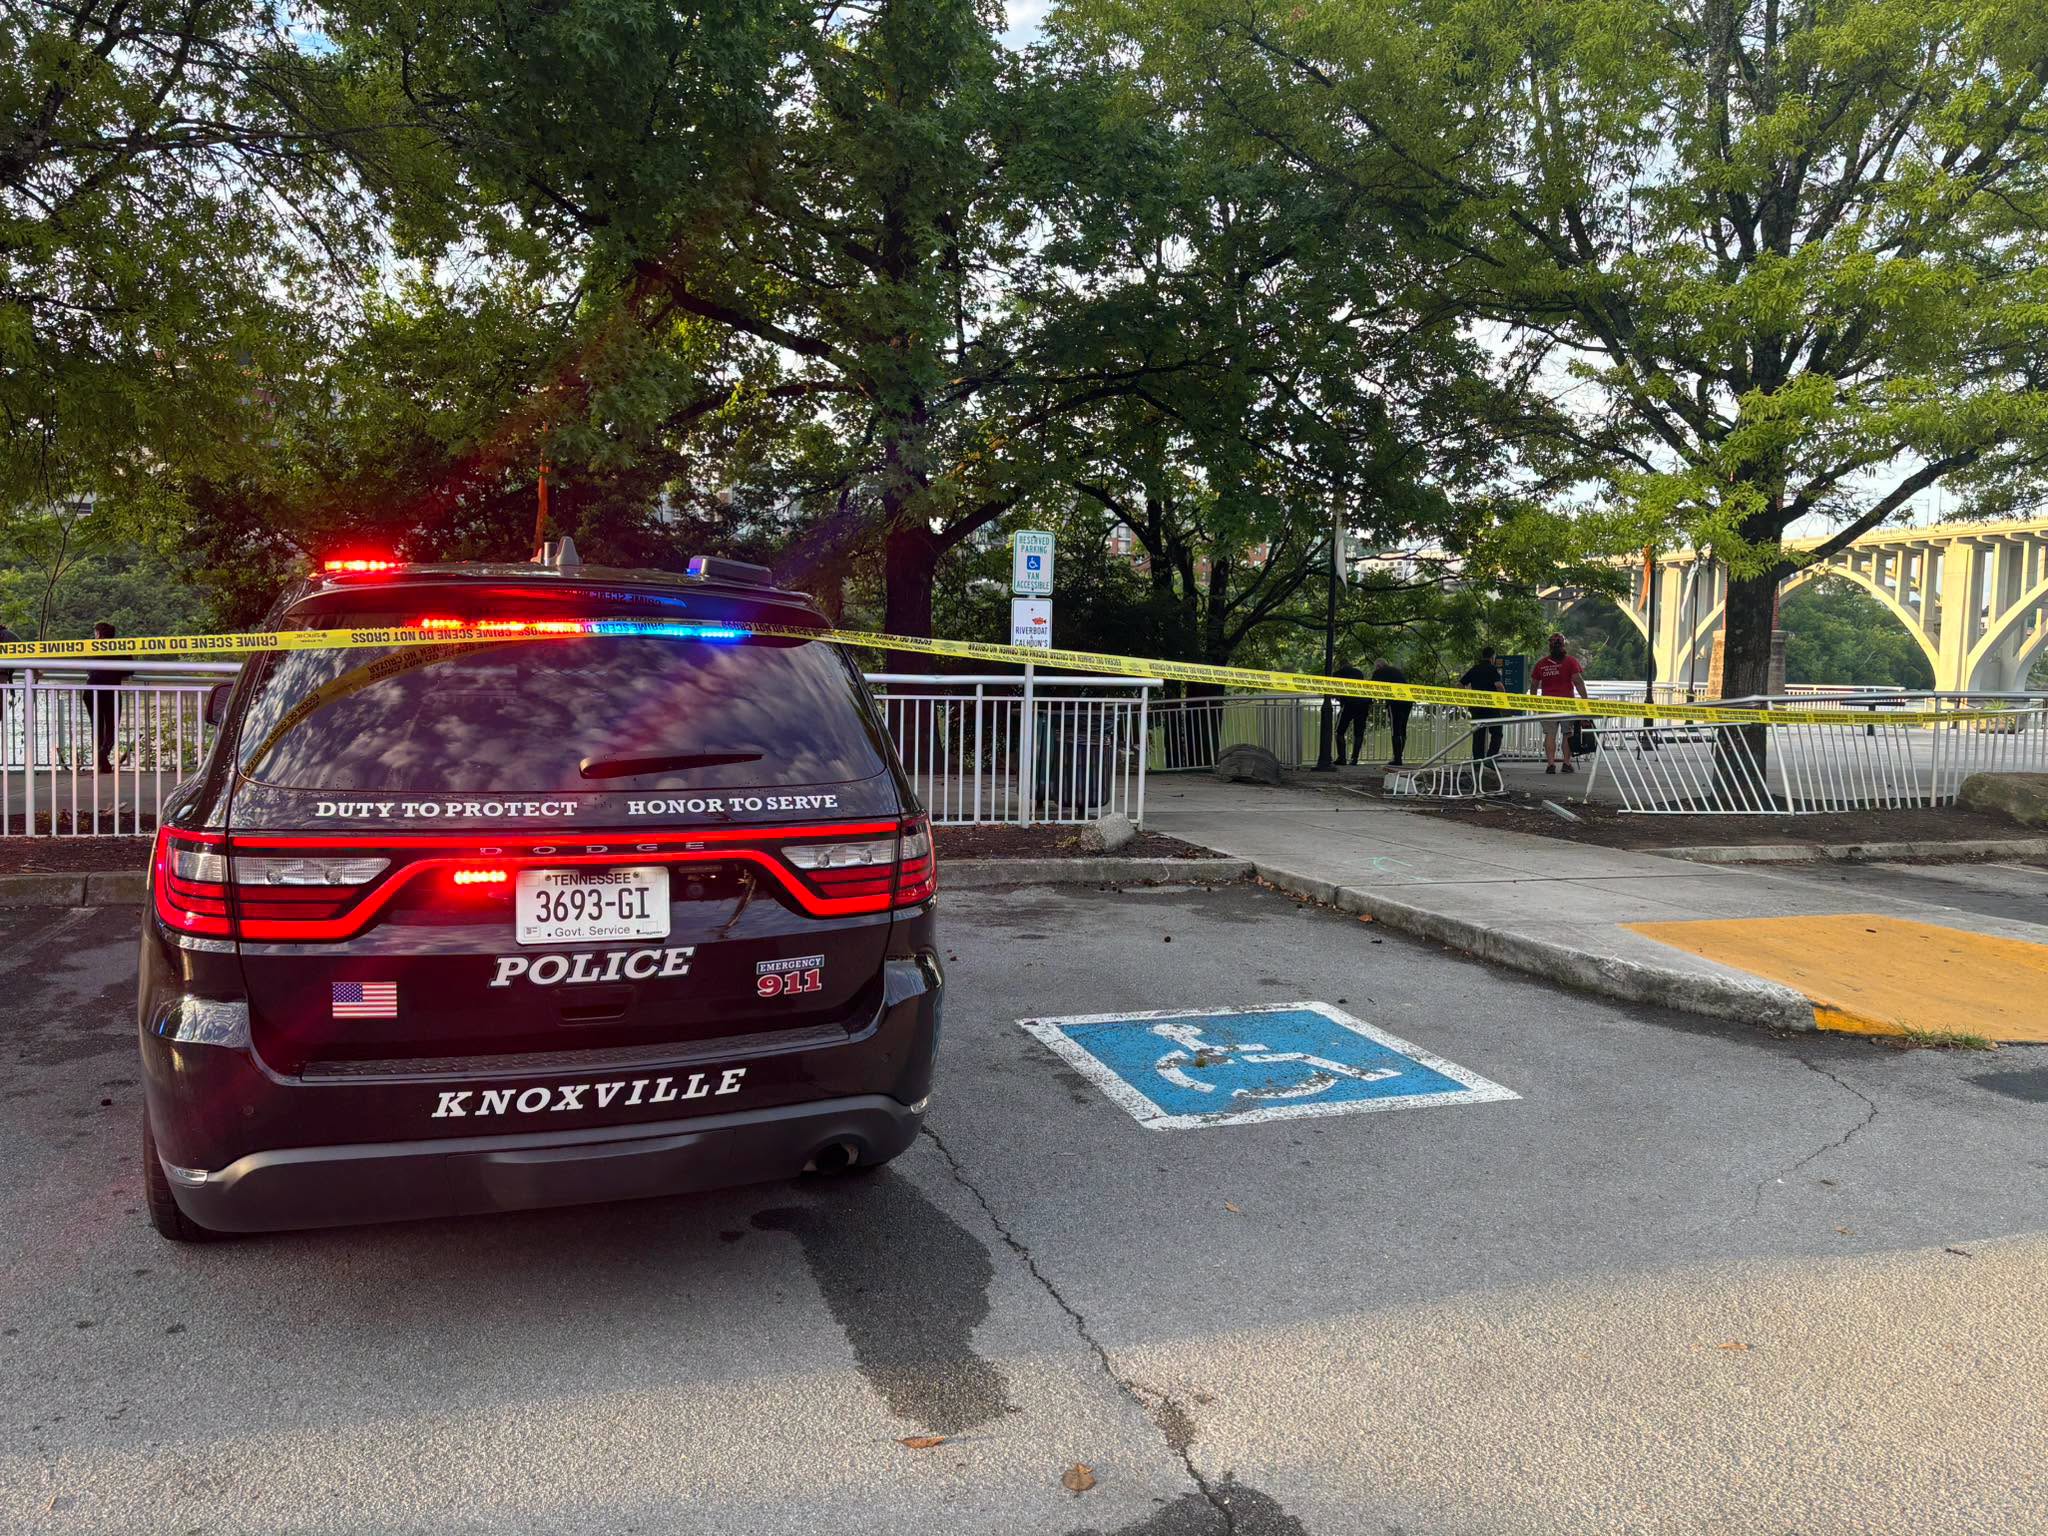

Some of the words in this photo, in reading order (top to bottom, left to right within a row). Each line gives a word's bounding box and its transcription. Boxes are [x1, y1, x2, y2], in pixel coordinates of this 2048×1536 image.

[1018, 535, 1050, 546] RESERVED
[1021, 545, 1047, 554] PARKING
[1027, 572, 1040, 580] VAN
[1016, 580, 1050, 590] ACCESSIBLE
[393, 631, 416, 642] NOT
[419, 630, 435, 641] DO
[437, 629, 473, 640] SCENE
[1015, 626, 1048, 635] RIVERBOAT
[191, 636, 233, 649] SCENE
[236, 635, 278, 648] CRIME
[351, 631, 390, 643] CROSS
[0, 644, 35, 654] SCEN
[39, 642, 85, 653] CRIME
[91, 640, 136, 652] CROSS
[140, 639, 166, 650] NOT
[169, 638, 188, 650] DO
[1015, 639, 1049, 648] CALHOUN'S
[367, 655, 402, 673] CRUZAR
[315, 801, 395, 818] DUTY
[401, 802, 441, 818] TO
[444, 801, 578, 817] PROTECT
[627, 798, 725, 815] HONOR
[729, 796, 763, 812] TO
[766, 794, 838, 810] SERVE
[479, 841, 705, 856] DODGE
[552, 872, 631, 887] TENNESSEE
[536, 887, 650, 923] 3693-GI
[555, 926, 584, 938] Govt.
[589, 924, 630, 937] Service
[488, 946, 696, 988] POLICE
[760, 957, 822, 972] EMERGENCY
[757, 968, 822, 998] 911
[431, 1067, 747, 1118] KNOXVILLE
